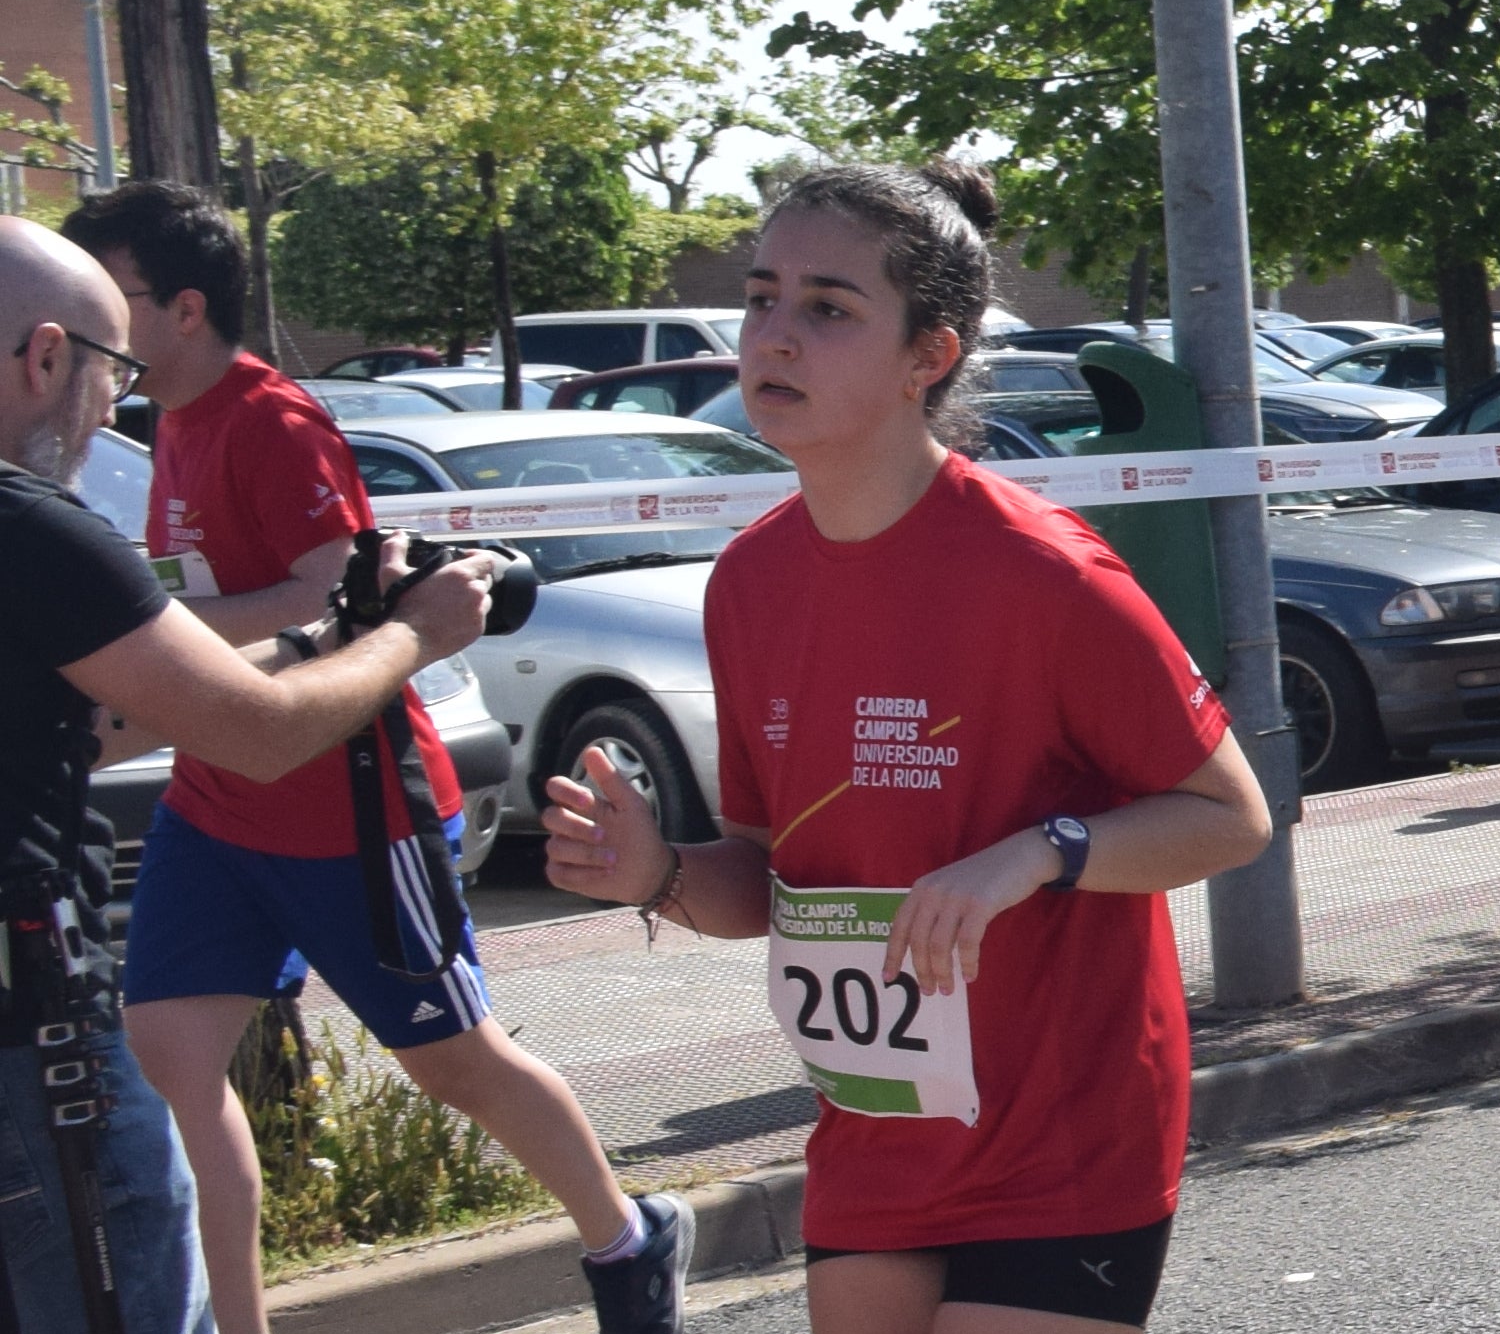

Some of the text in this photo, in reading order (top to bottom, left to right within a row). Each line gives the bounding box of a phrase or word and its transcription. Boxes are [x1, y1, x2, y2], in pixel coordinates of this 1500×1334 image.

[664, 493, 729, 505] UNIVERSIDAD
[855, 697, 928, 718] CARRERA
[854, 720, 919, 741] CAMPUS
[854, 743, 959, 767] UNIVERSIDAD
[853, 766, 942, 789] DE LA RIOJA
[799, 903, 857, 918] CAMPUS
[828, 920, 845, 935] DE
[847, 920, 867, 935] LA
[868, 921, 892, 936] RIO
[784, 965, 929, 1053] 202
